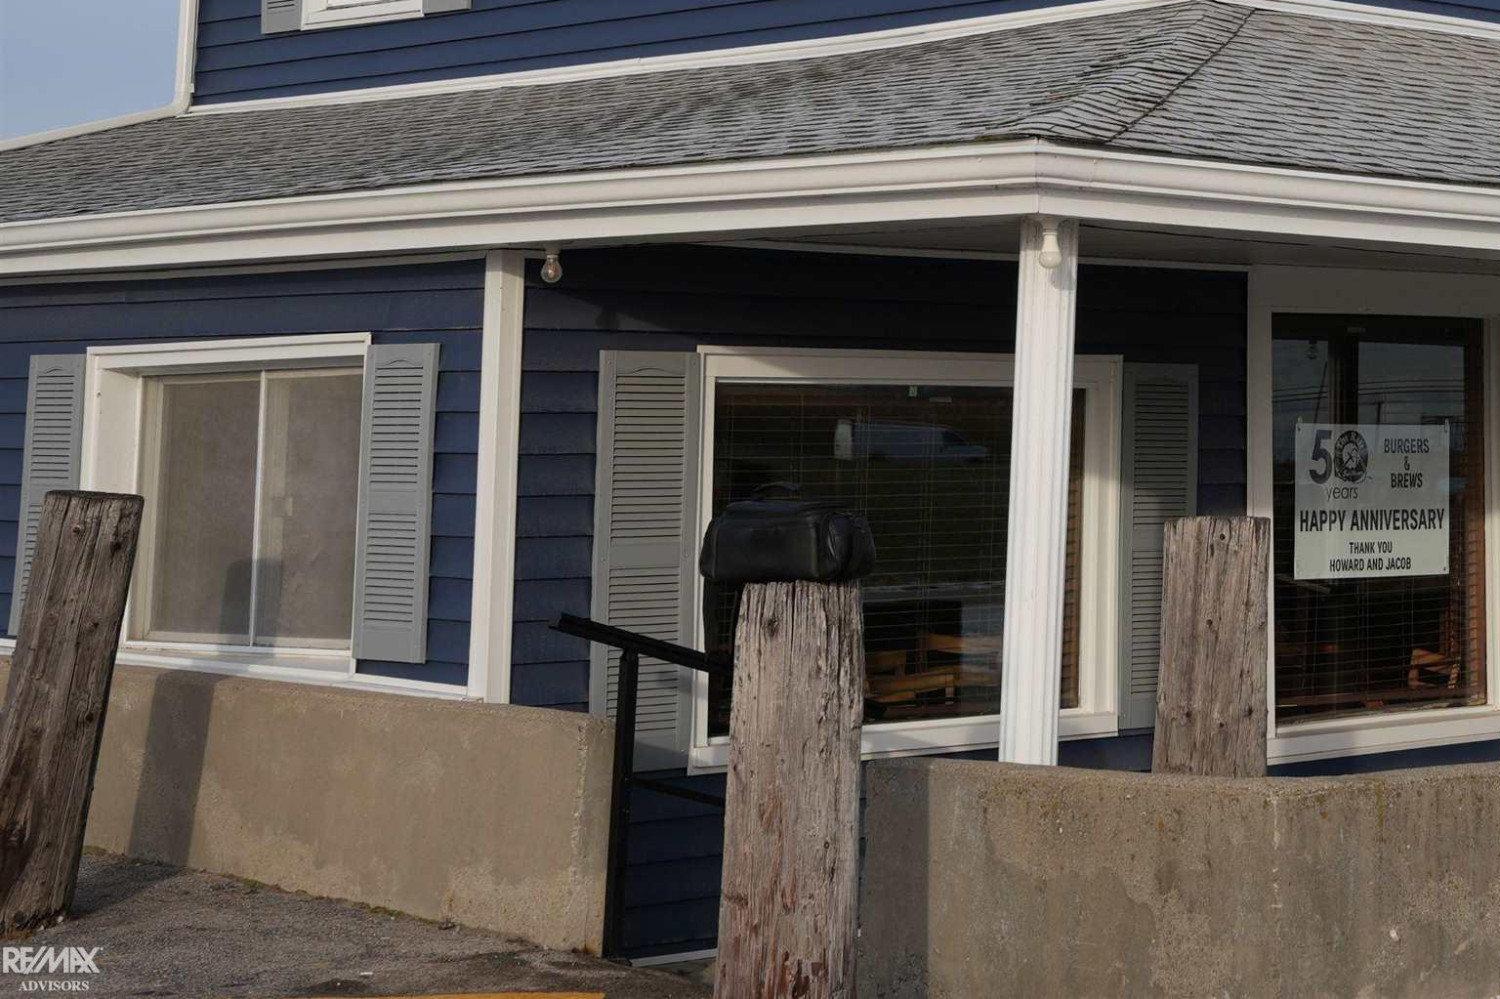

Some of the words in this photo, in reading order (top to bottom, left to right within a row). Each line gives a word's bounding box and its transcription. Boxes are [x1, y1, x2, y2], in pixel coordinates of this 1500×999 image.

[1384, 438, 1430, 454] BURGERS
[1403, 456, 1411, 471] &
[1390, 472, 1423, 488] BREWS
[1327, 486, 1359, 501] years
[1300, 510, 1346, 532] HAPPY
[1350, 508, 1445, 531] ANNIVERSARY
[1349, 542, 1375, 554] THANK
[1377, 541, 1393, 553] YOU
[1329, 559, 1365, 572] HOWARD
[1366, 558, 1383, 571] AND
[1385, 557, 1411, 570] JACOB
